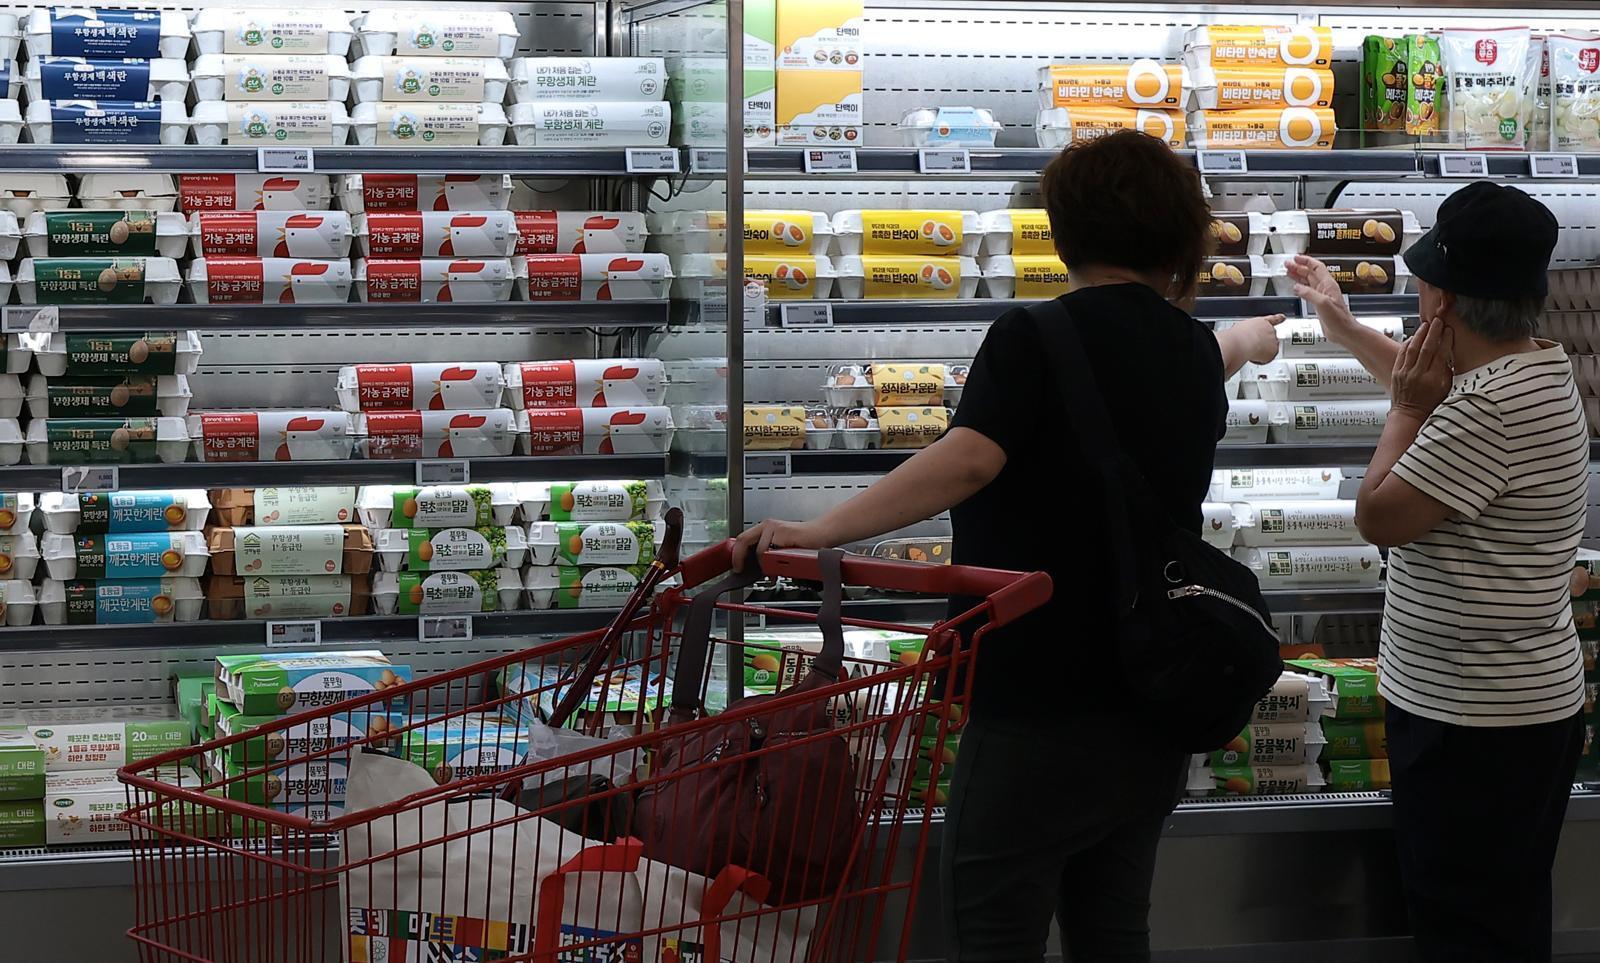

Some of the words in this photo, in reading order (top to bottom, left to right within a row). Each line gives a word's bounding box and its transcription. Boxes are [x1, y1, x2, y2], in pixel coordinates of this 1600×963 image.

[836, 28, 859, 36] 단백이
[1216, 48, 1245, 58] 비타민
[1248, 48, 1278, 58] 반숙란
[537, 76, 575, 87] 무항생제
[578, 76, 596, 86] 계란
[1058, 86, 1090, 98] 비타민
[1092, 86, 1124, 98] 반숙란
[1222, 88, 1252, 100] 비타민
[1253, 88, 1281, 100] 반숙란
[748, 101, 771, 109] 단백이
[835, 104, 858, 112] 단백이
[544, 120, 583, 130] 무항생제
[585, 120, 604, 130] 계란
[1212, 130, 1244, 142] 비타민
[1246, 130, 1278, 142] 반숙란
[52, 234, 88, 244] 무항생제
[91, 234, 108, 244] 특란
[744, 230, 768, 240] 반숙이
[893, 230, 919, 240] 반숙이
[893, 273, 917, 284] 반숙이
[1042, 273, 1068, 284] 반숙이
[40, 281, 77, 291] 무항생제
[80, 281, 96, 290] 특란
[71, 352, 108, 363] 무항생제
[110, 352, 128, 363] 특란
[53, 441, 89, 451] 무항생제
[92, 441, 109, 450] 특란
[420, 501, 436, 513] 목초
[577, 495, 592, 508] 목초
[83, 510, 108, 519] 무항생제
[436, 544, 451, 556] 목초
[586, 538, 600, 551] 목초
[79, 554, 104, 563] 무항생제
[110, 553, 160, 566] 깨끗한계란
[426, 588, 442, 599] 목초
[298, 691, 345, 707] 무항생제
[1258, 696, 1299, 711] 동물복지
[1255, 739, 1296, 754] 동물복지
